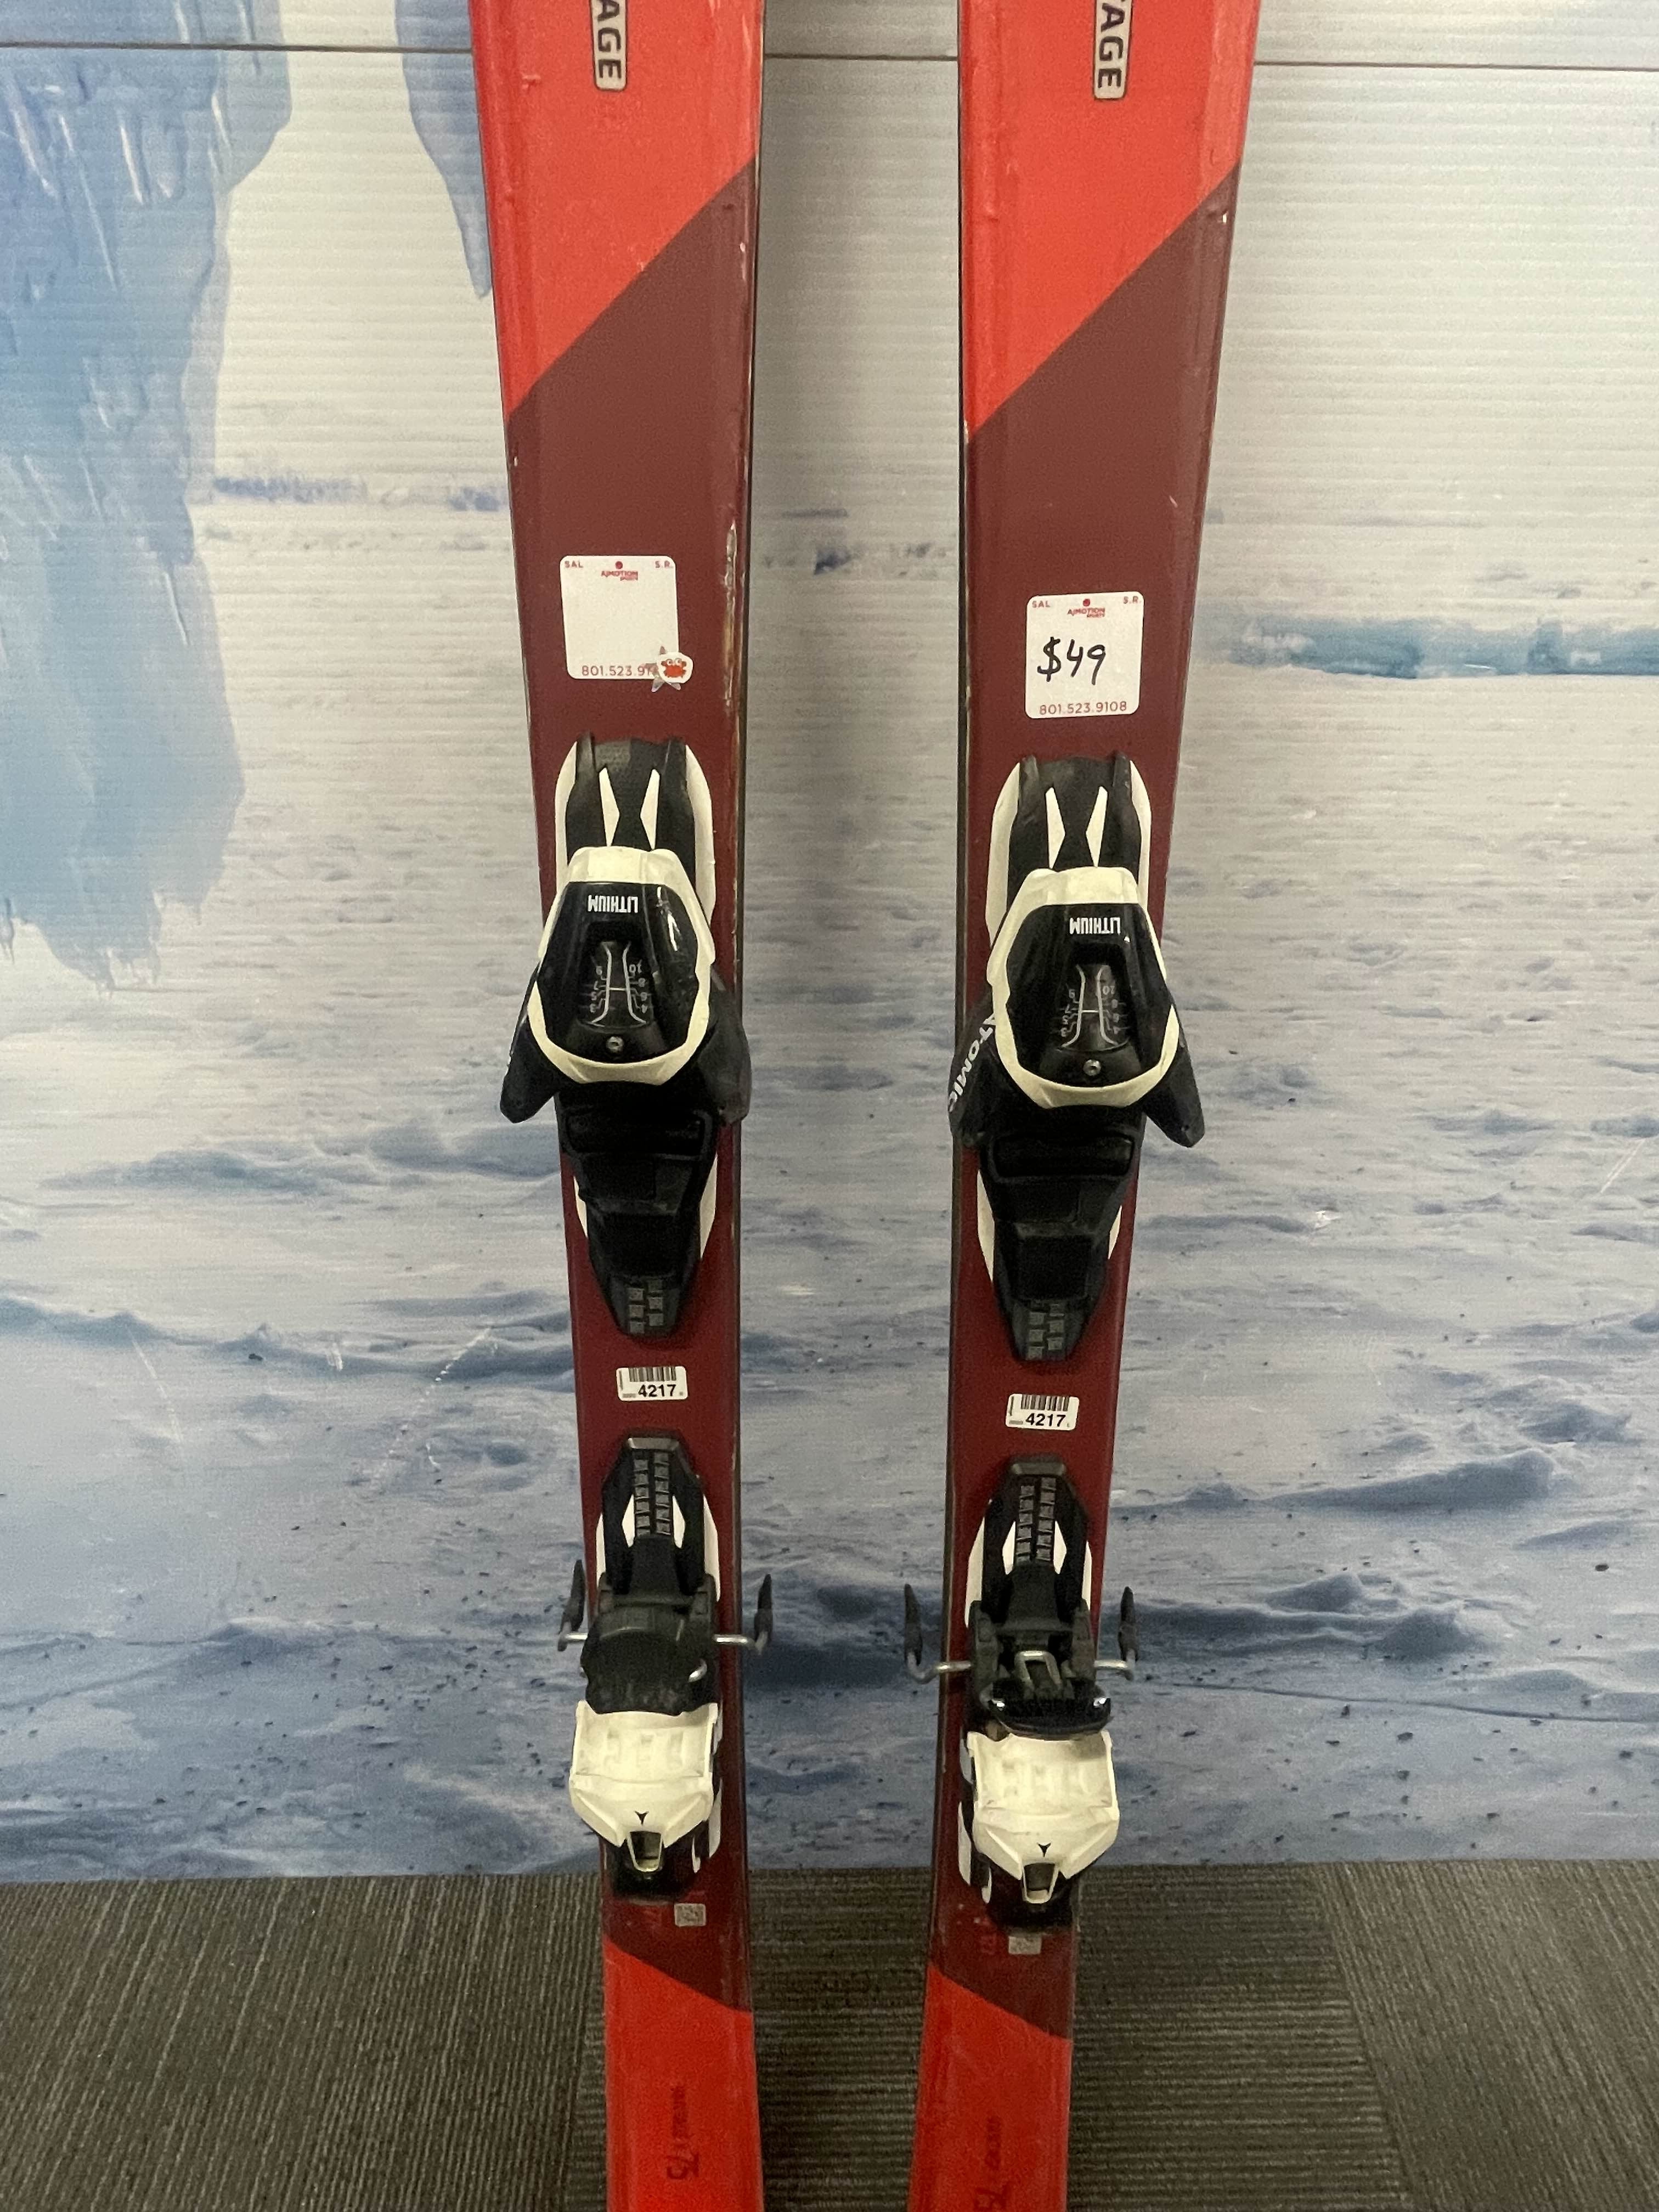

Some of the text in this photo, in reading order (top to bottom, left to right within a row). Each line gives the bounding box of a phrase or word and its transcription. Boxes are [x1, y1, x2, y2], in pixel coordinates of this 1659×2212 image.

[564, 560, 584, 568] SAL
[1031, 600, 1051, 608] SAL
[1037, 636, 1106, 686] $49
[582, 664, 653, 677] 801.523.91
[1039, 700, 1127, 716] 801.523.9108
[588, 894, 639, 913] LITHIUM
[1069, 917, 1121, 935] LITHIUM
[638, 1384, 676, 1398] 4217
[1025, 1412, 1066, 1426] 4217
